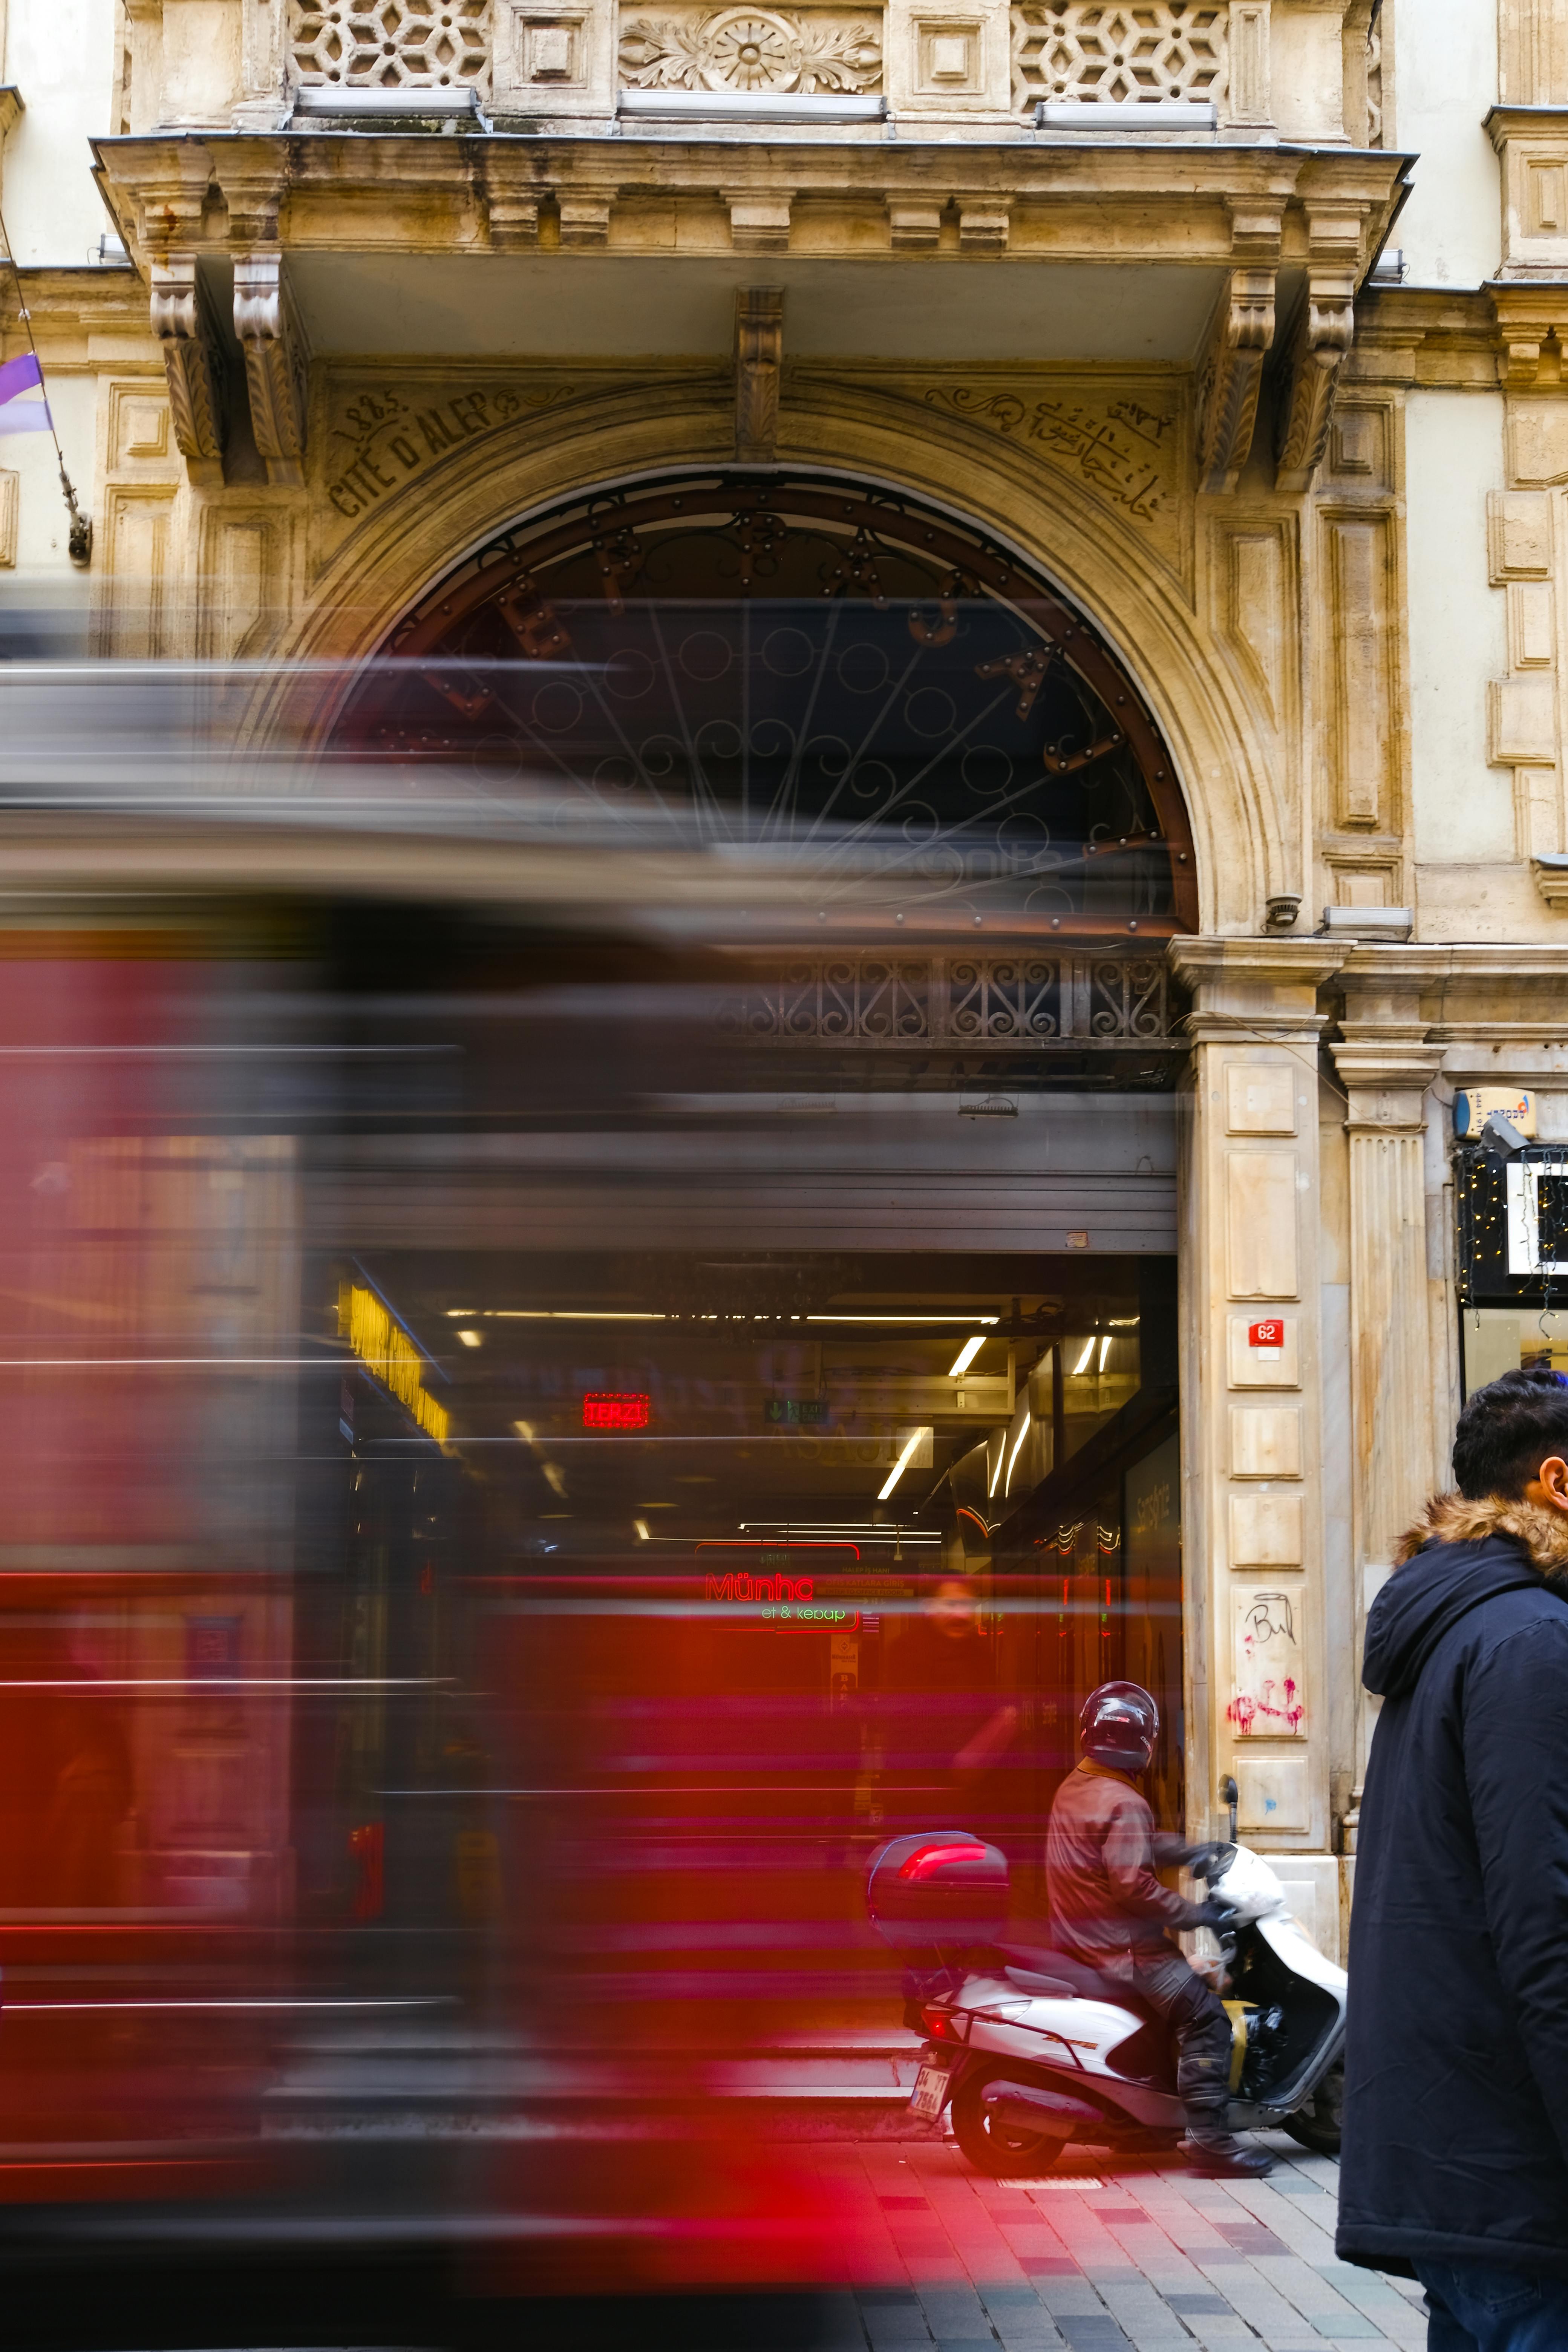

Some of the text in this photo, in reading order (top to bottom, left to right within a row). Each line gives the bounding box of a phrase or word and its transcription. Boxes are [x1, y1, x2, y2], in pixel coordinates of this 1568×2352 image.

[1258, 1325, 1275, 1339] 62
[762, 1607, 776, 1619] et
[781, 1605, 792, 1619] &
